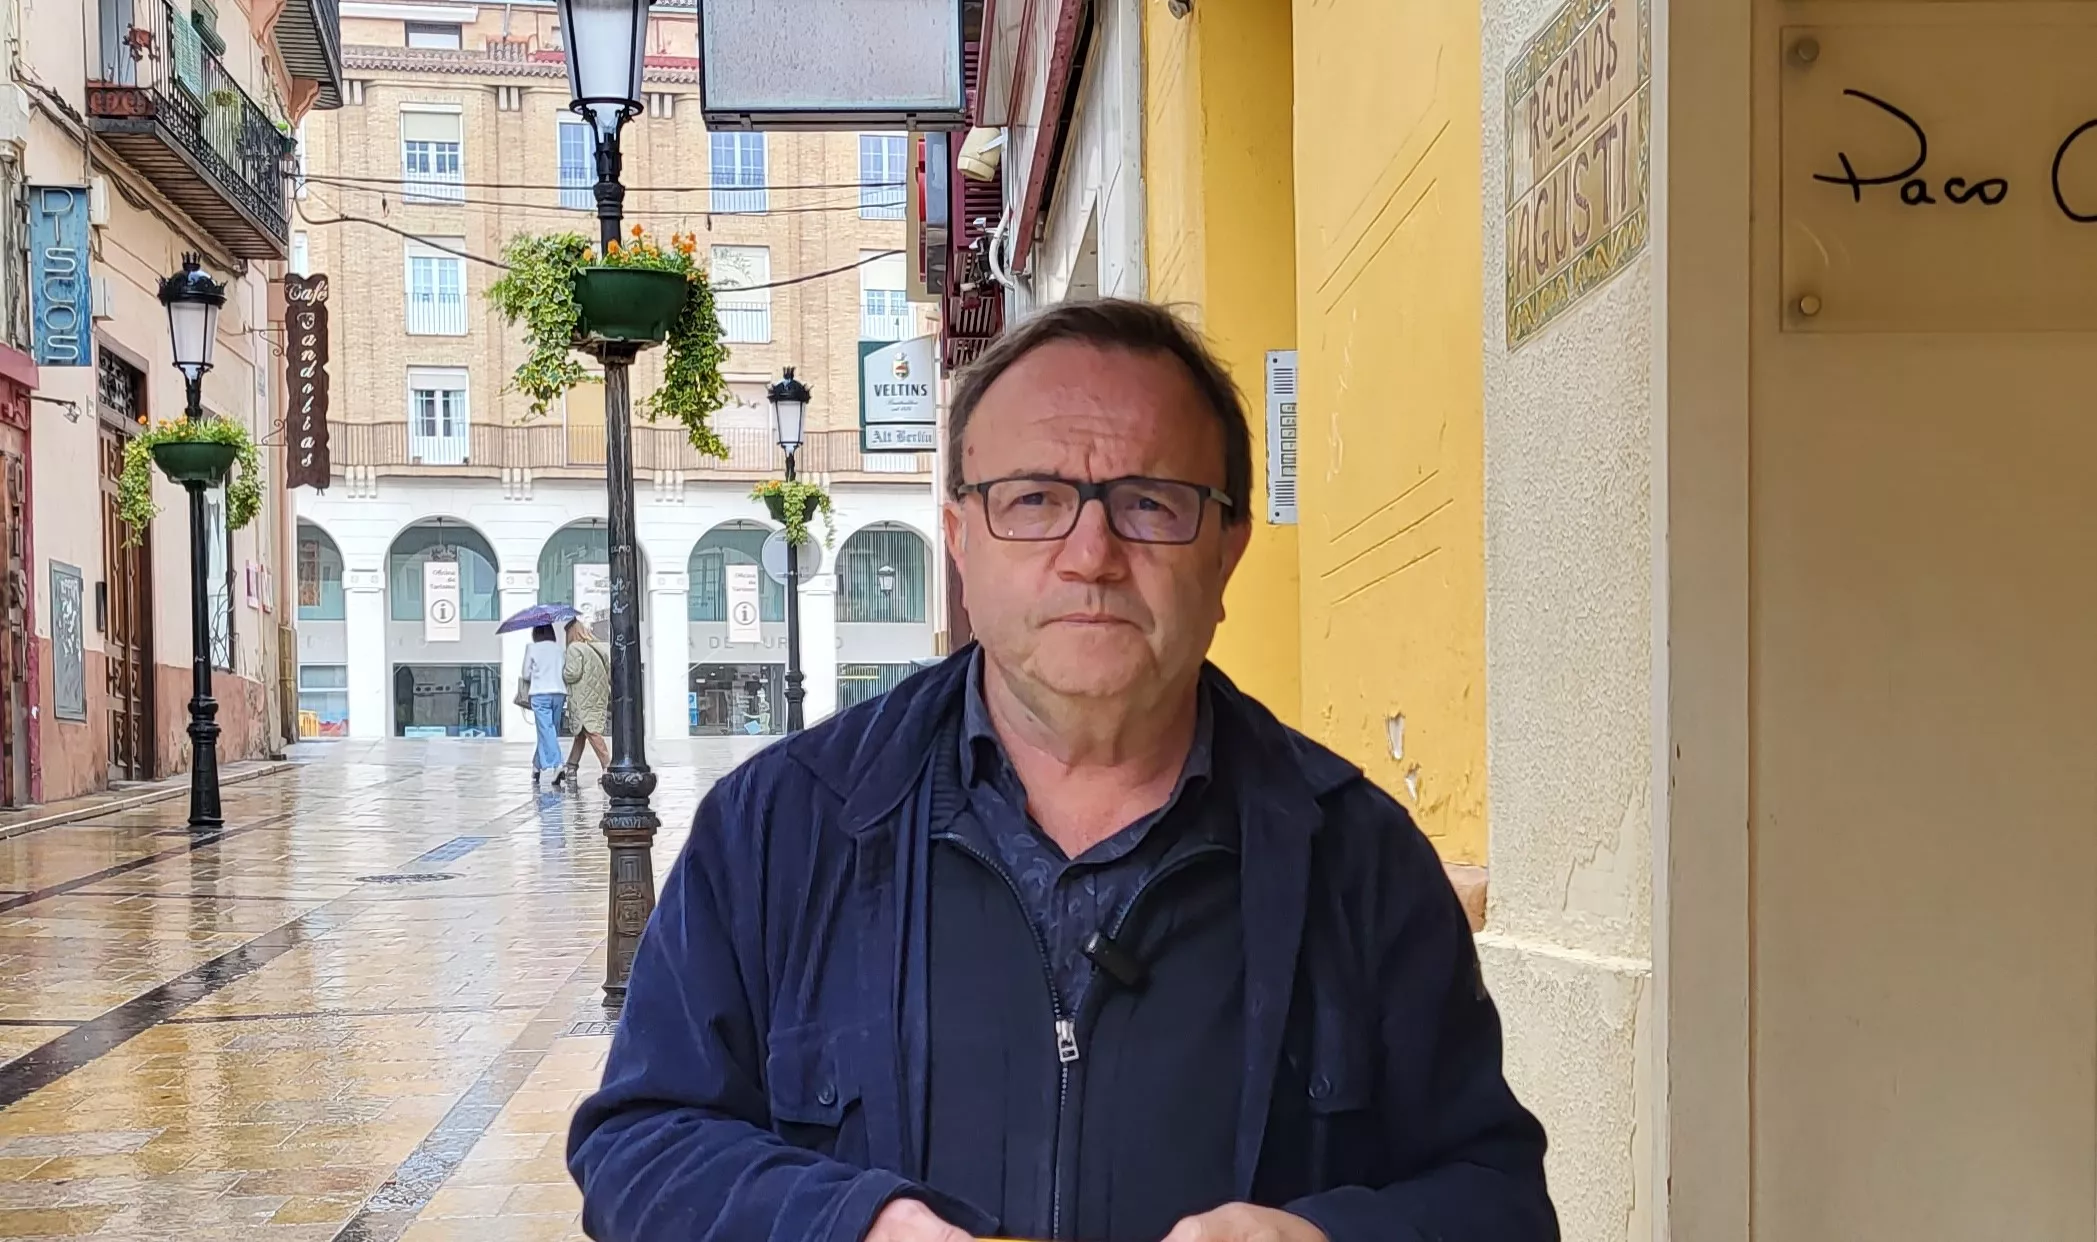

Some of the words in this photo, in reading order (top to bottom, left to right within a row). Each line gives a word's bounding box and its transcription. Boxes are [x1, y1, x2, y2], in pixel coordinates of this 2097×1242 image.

[1528, 6, 1618, 159] REGALOS
[1812, 88, 2009, 206] Paco
[1516, 111, 1628, 297] AGUSTI
[40, 187, 79, 360] DISCOS
[285, 281, 328, 307] Café
[873, 383, 928, 397] VELTINS
